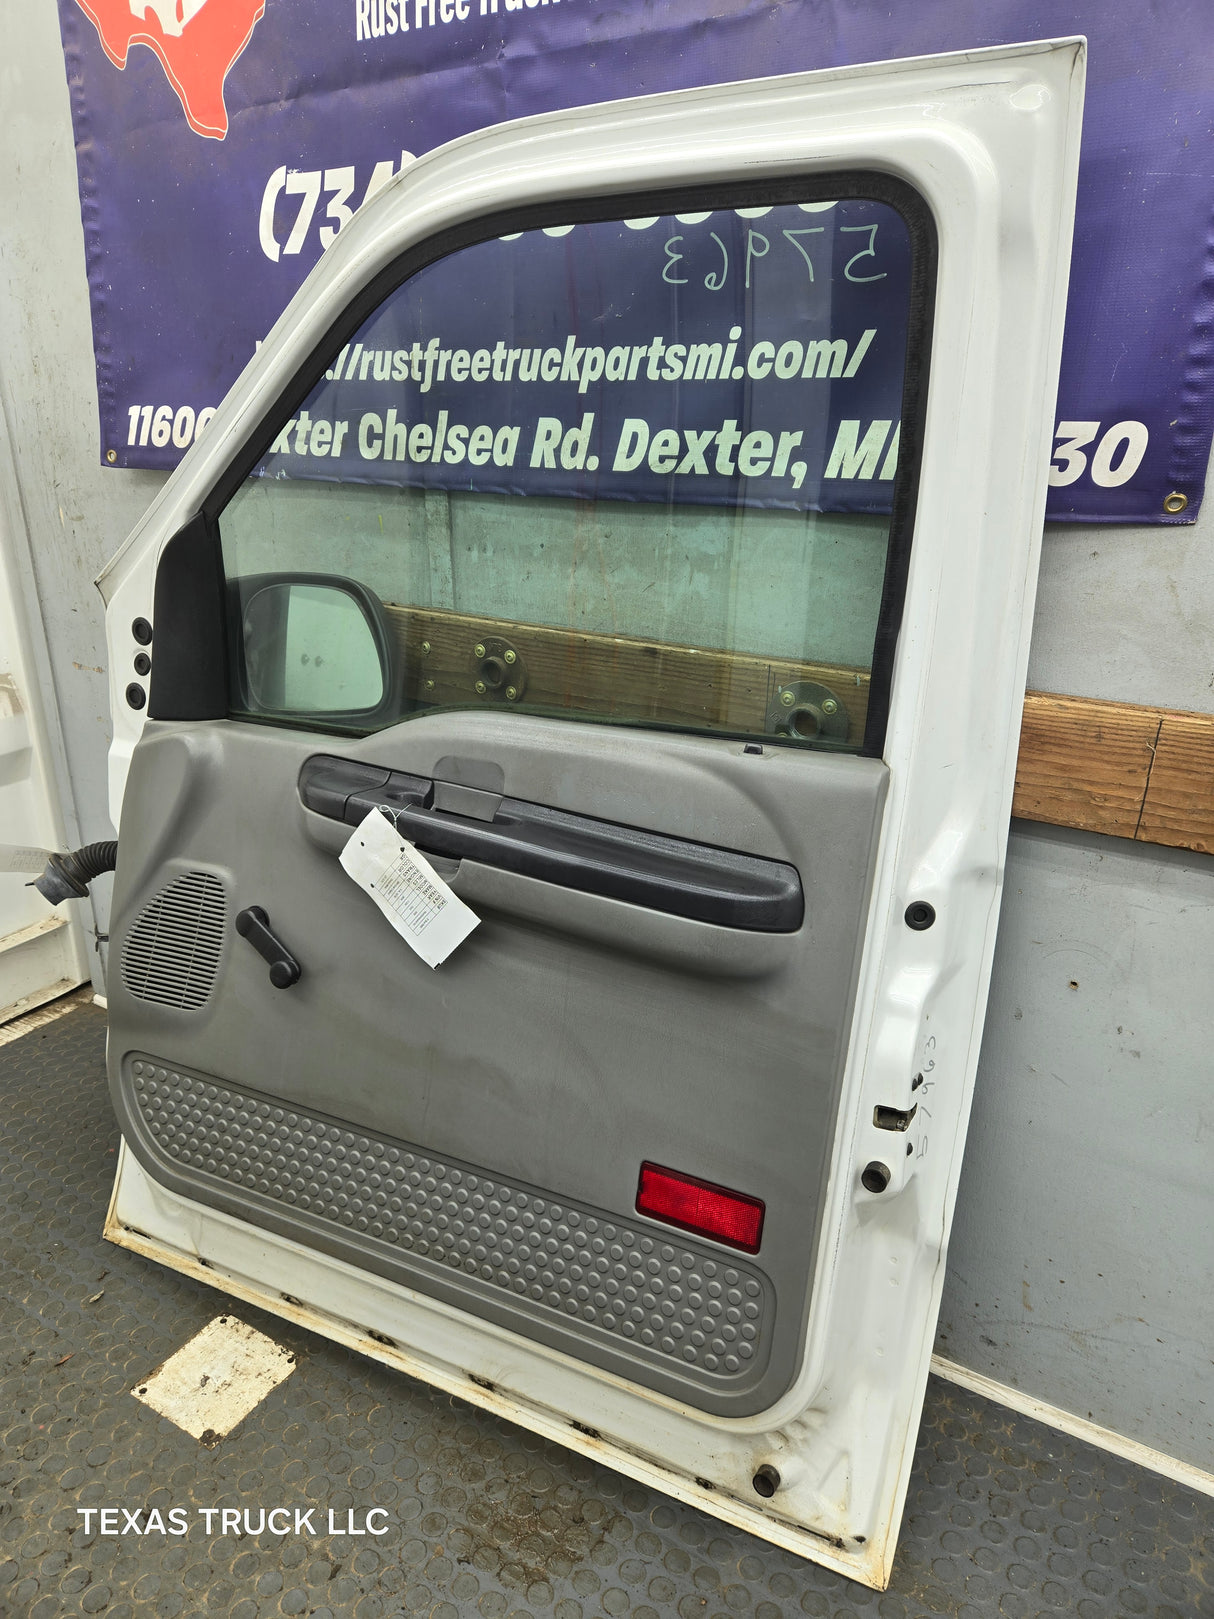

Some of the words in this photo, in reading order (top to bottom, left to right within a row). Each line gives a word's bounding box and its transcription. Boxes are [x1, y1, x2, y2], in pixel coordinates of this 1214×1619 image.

[355, 0, 410, 41] Rust
[358, 409, 521, 467] Chelsea
[529, 412, 600, 471] Rd.
[612, 418, 808, 489] Dexter,
